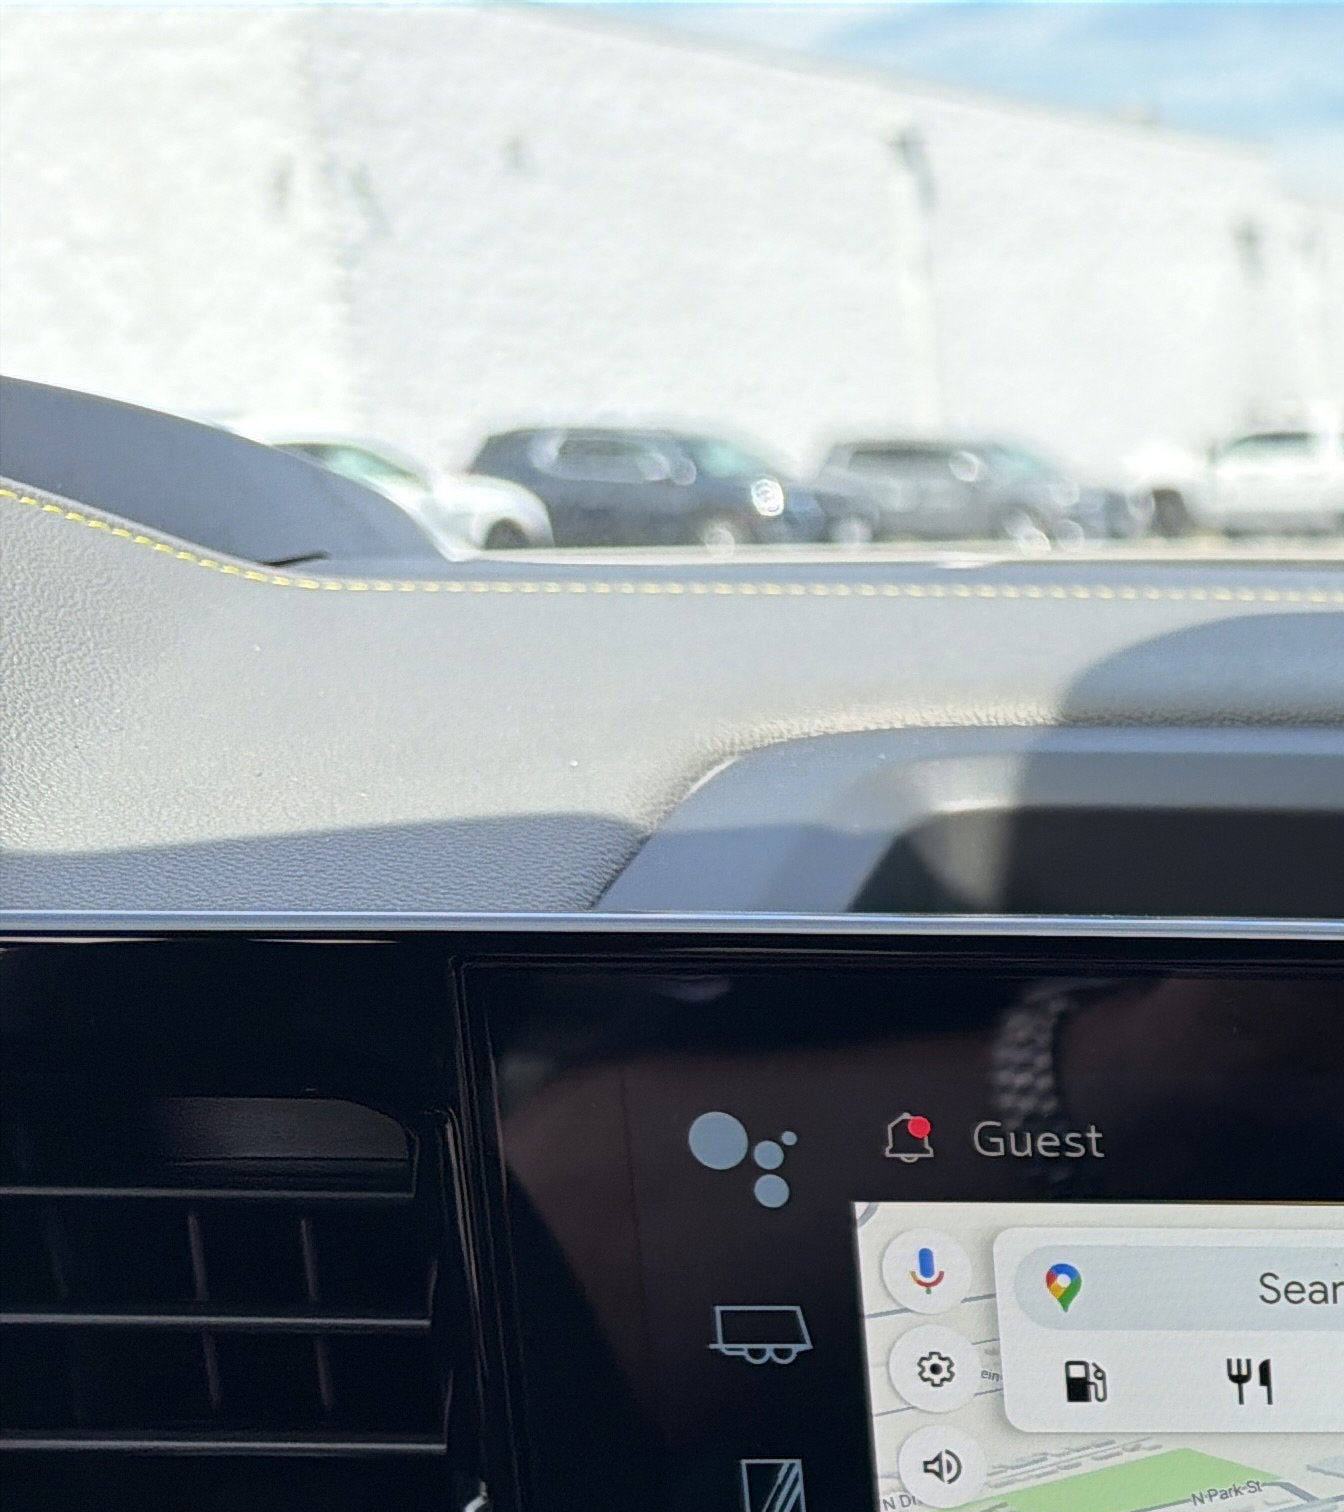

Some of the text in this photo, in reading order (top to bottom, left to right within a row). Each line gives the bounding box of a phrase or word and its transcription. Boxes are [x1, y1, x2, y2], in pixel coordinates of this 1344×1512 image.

[973, 1120, 1105, 1159] Guest
[882, 1498, 896, 1511] N
[1192, 1480, 1263, 1505] N Park St
